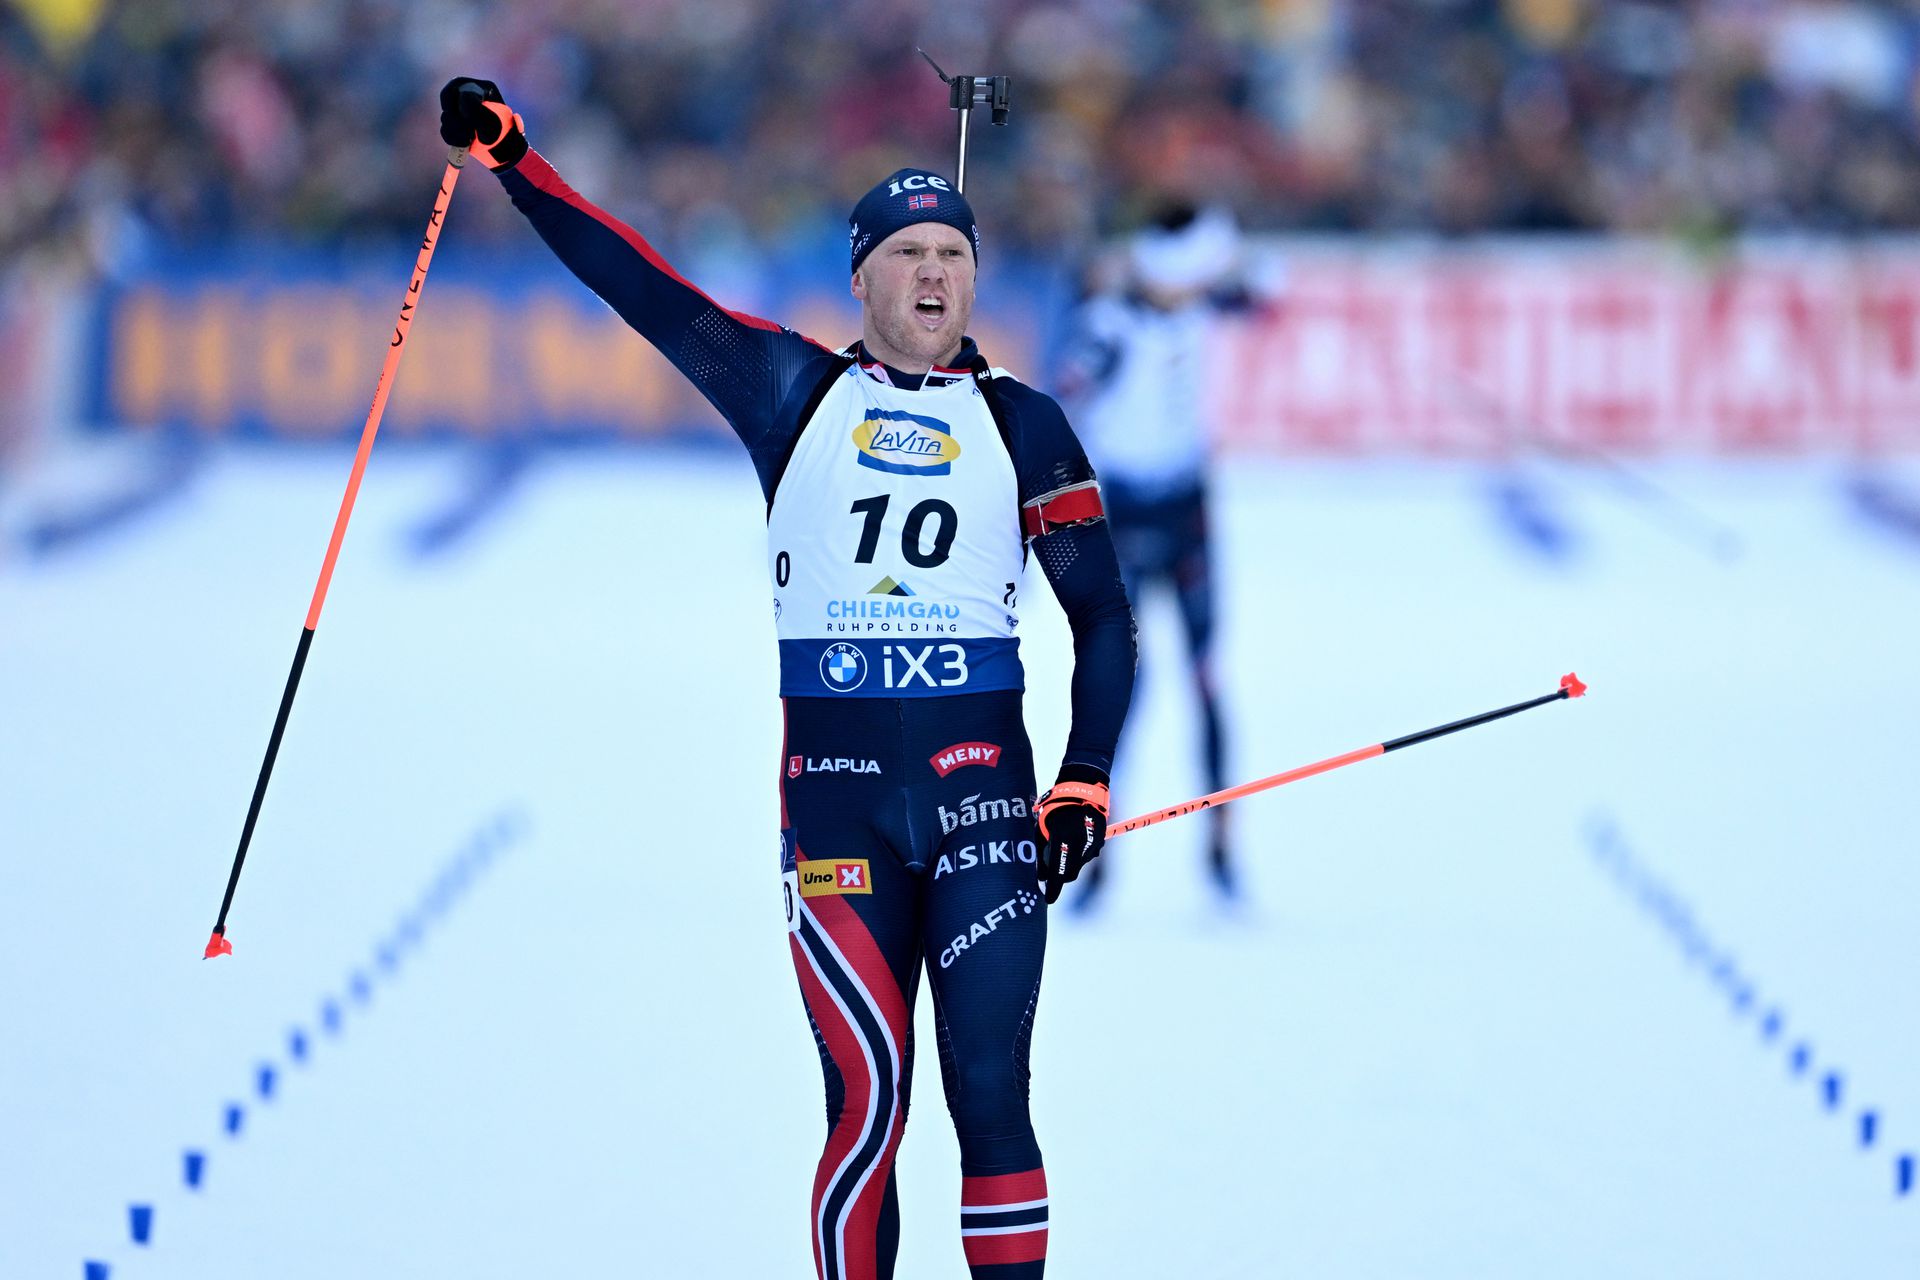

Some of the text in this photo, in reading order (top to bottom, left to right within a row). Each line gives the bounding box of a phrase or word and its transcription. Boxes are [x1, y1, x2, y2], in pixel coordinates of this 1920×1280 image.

[889, 175, 950, 197] ice
[850, 494, 958, 568] 10
[827, 601, 960, 619] CHIEMGAU
[827, 623, 957, 632] RUHPOLDING
[827, 645, 860, 659] BMW
[883, 644, 969, 688] iX3
[806, 758, 882, 774] LAPUA
[938, 747, 996, 770] MENY
[803, 866, 861, 886] Uno X
[940, 899, 1017, 969] CRAFT
